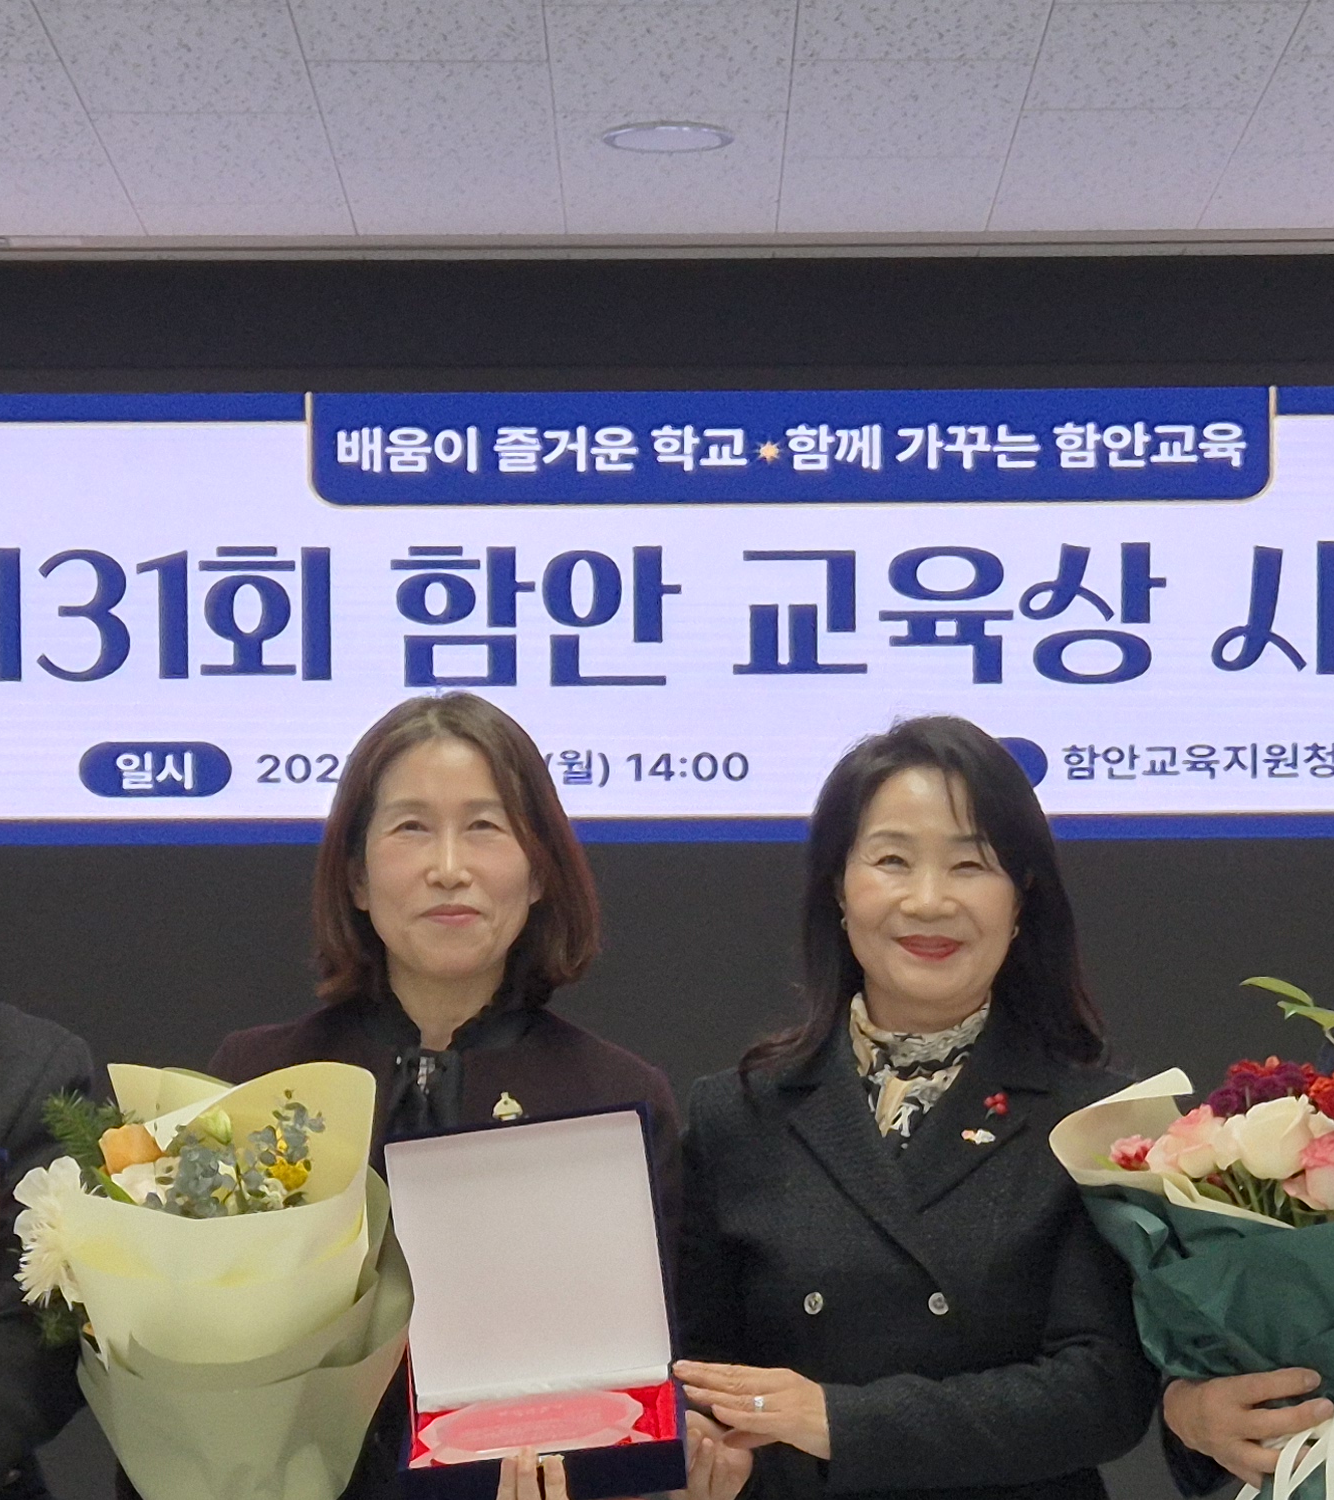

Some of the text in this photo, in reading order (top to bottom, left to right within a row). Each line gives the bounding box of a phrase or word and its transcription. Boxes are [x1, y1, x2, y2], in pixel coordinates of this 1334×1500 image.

[336, 420, 1247, 474] 배움이 즐거운 학교 함께 가꾸는 함안교육
[390, 545, 683, 687] 함안
[732, 542, 1167, 684] 교육상
[115, 750, 196, 791] 일시
[256, 753, 352, 784] 202
[626, 751, 749, 782] 14:00
